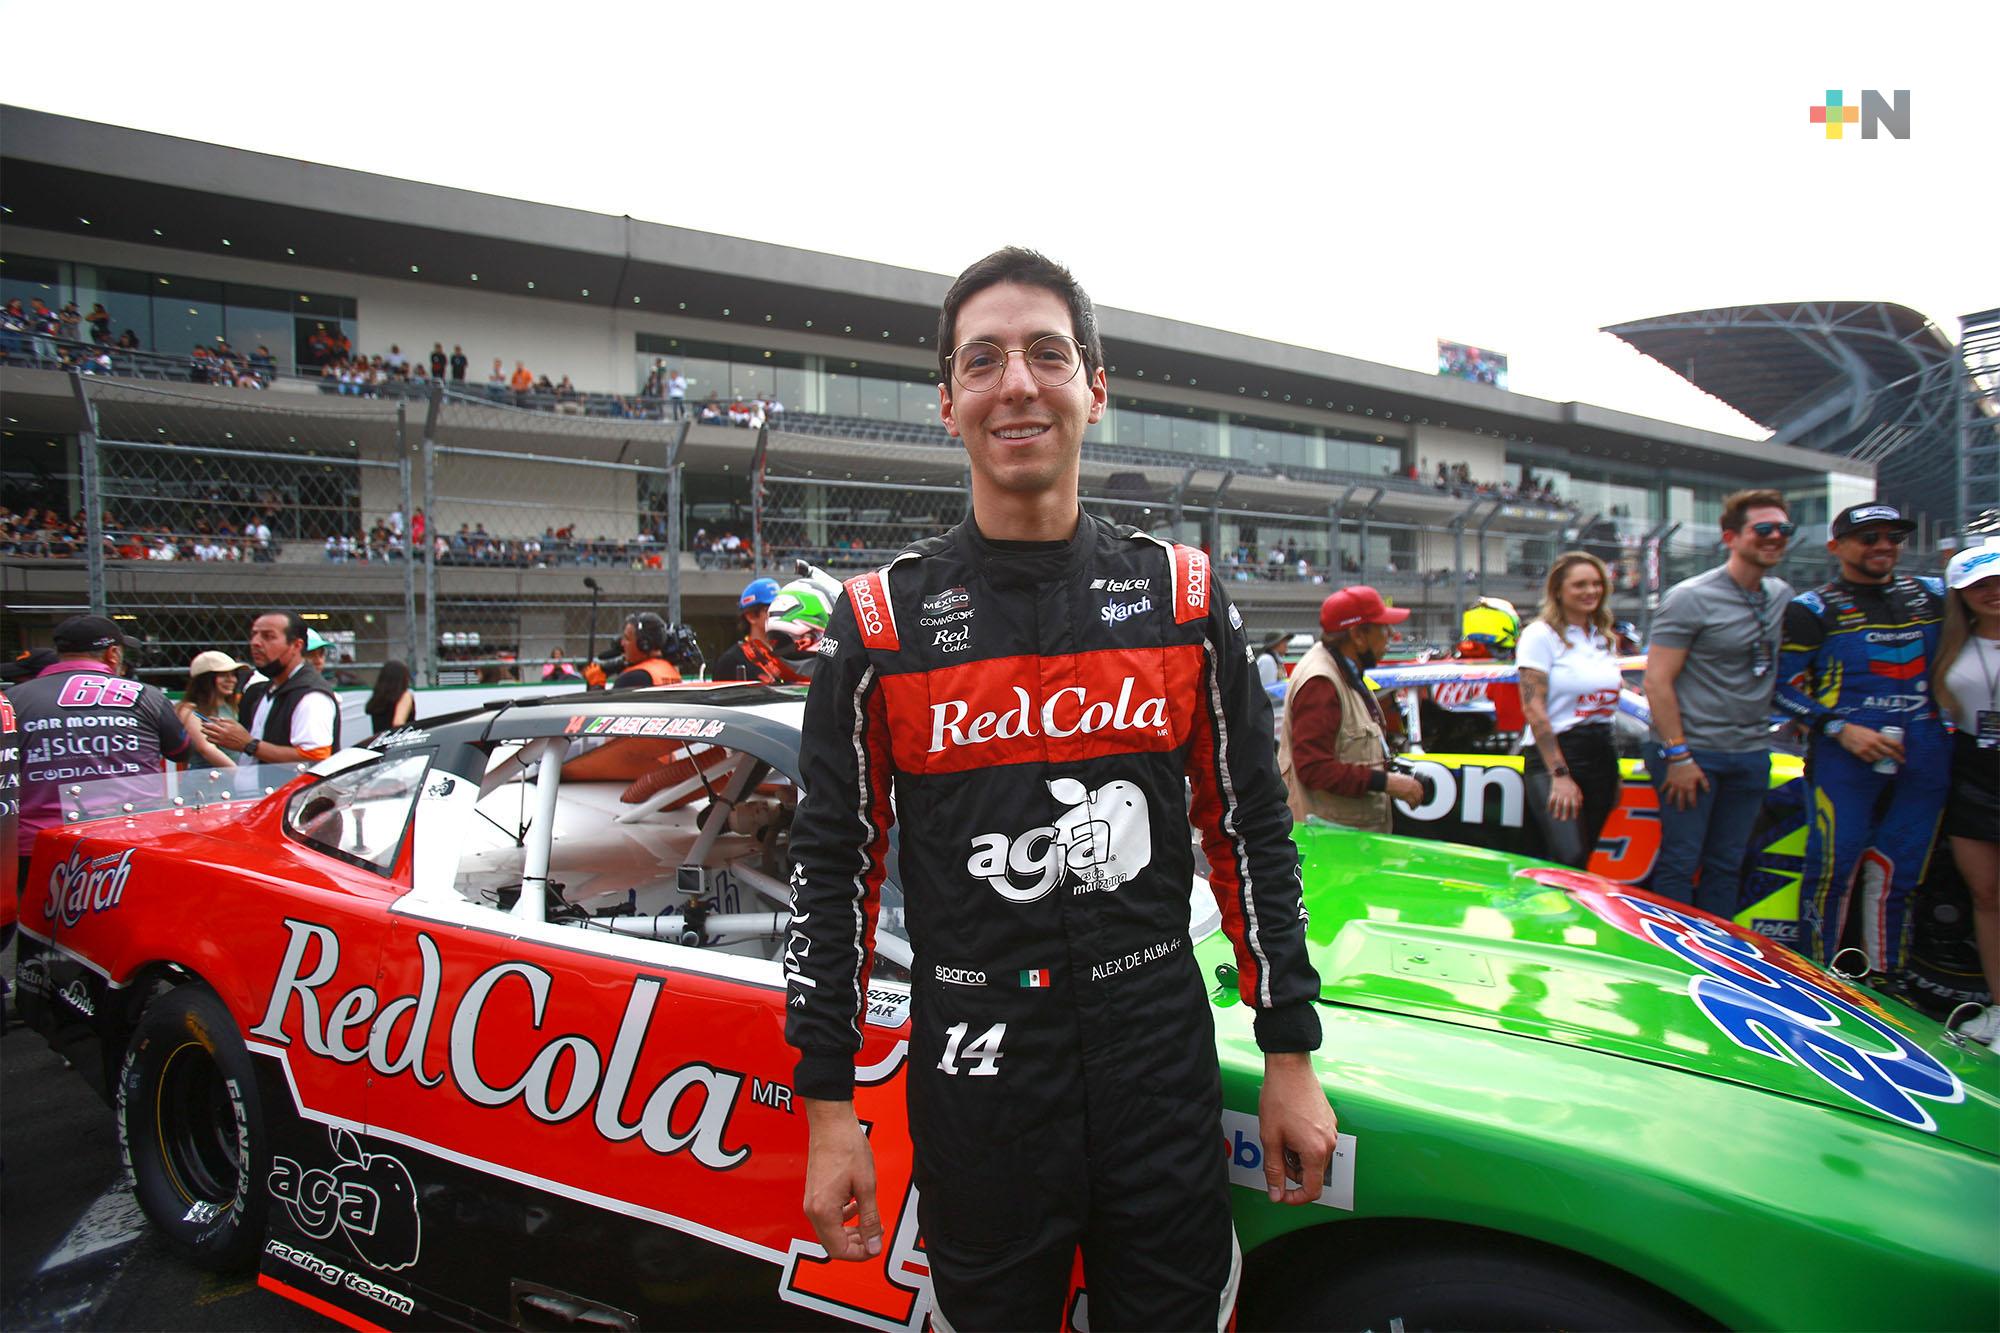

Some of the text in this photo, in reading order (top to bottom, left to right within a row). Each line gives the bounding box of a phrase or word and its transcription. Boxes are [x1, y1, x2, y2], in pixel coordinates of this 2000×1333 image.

[1107, 578, 1151, 592] telcel
[852, 579, 883, 637] sparco
[920, 609, 975, 627] COMMSCOPE
[932, 624, 970, 646] Red
[942, 641, 968, 653] Cola
[57, 674, 144, 708] 66
[24, 717, 63, 733] CAR
[927, 676, 1168, 753] Red Cola
[1157, 729, 1169, 737] MR
[28, 762, 141, 781] CODIALUB
[967, 819, 1111, 904] aga
[1073, 872, 1128, 896] manzana
[936, 965, 987, 985] sparco
[1091, 957, 1123, 982] ALEX
[1124, 951, 1142, 971] DE
[1143, 940, 1171, 964] ALBA
[249, 917, 793, 1172] Red Cola MR
[937, 1021, 1007, 1076] 14
[226, 1078, 250, 1228] GENERAL
[267, 1155, 381, 1240] aga
[265, 1239, 415, 1316] racing team
